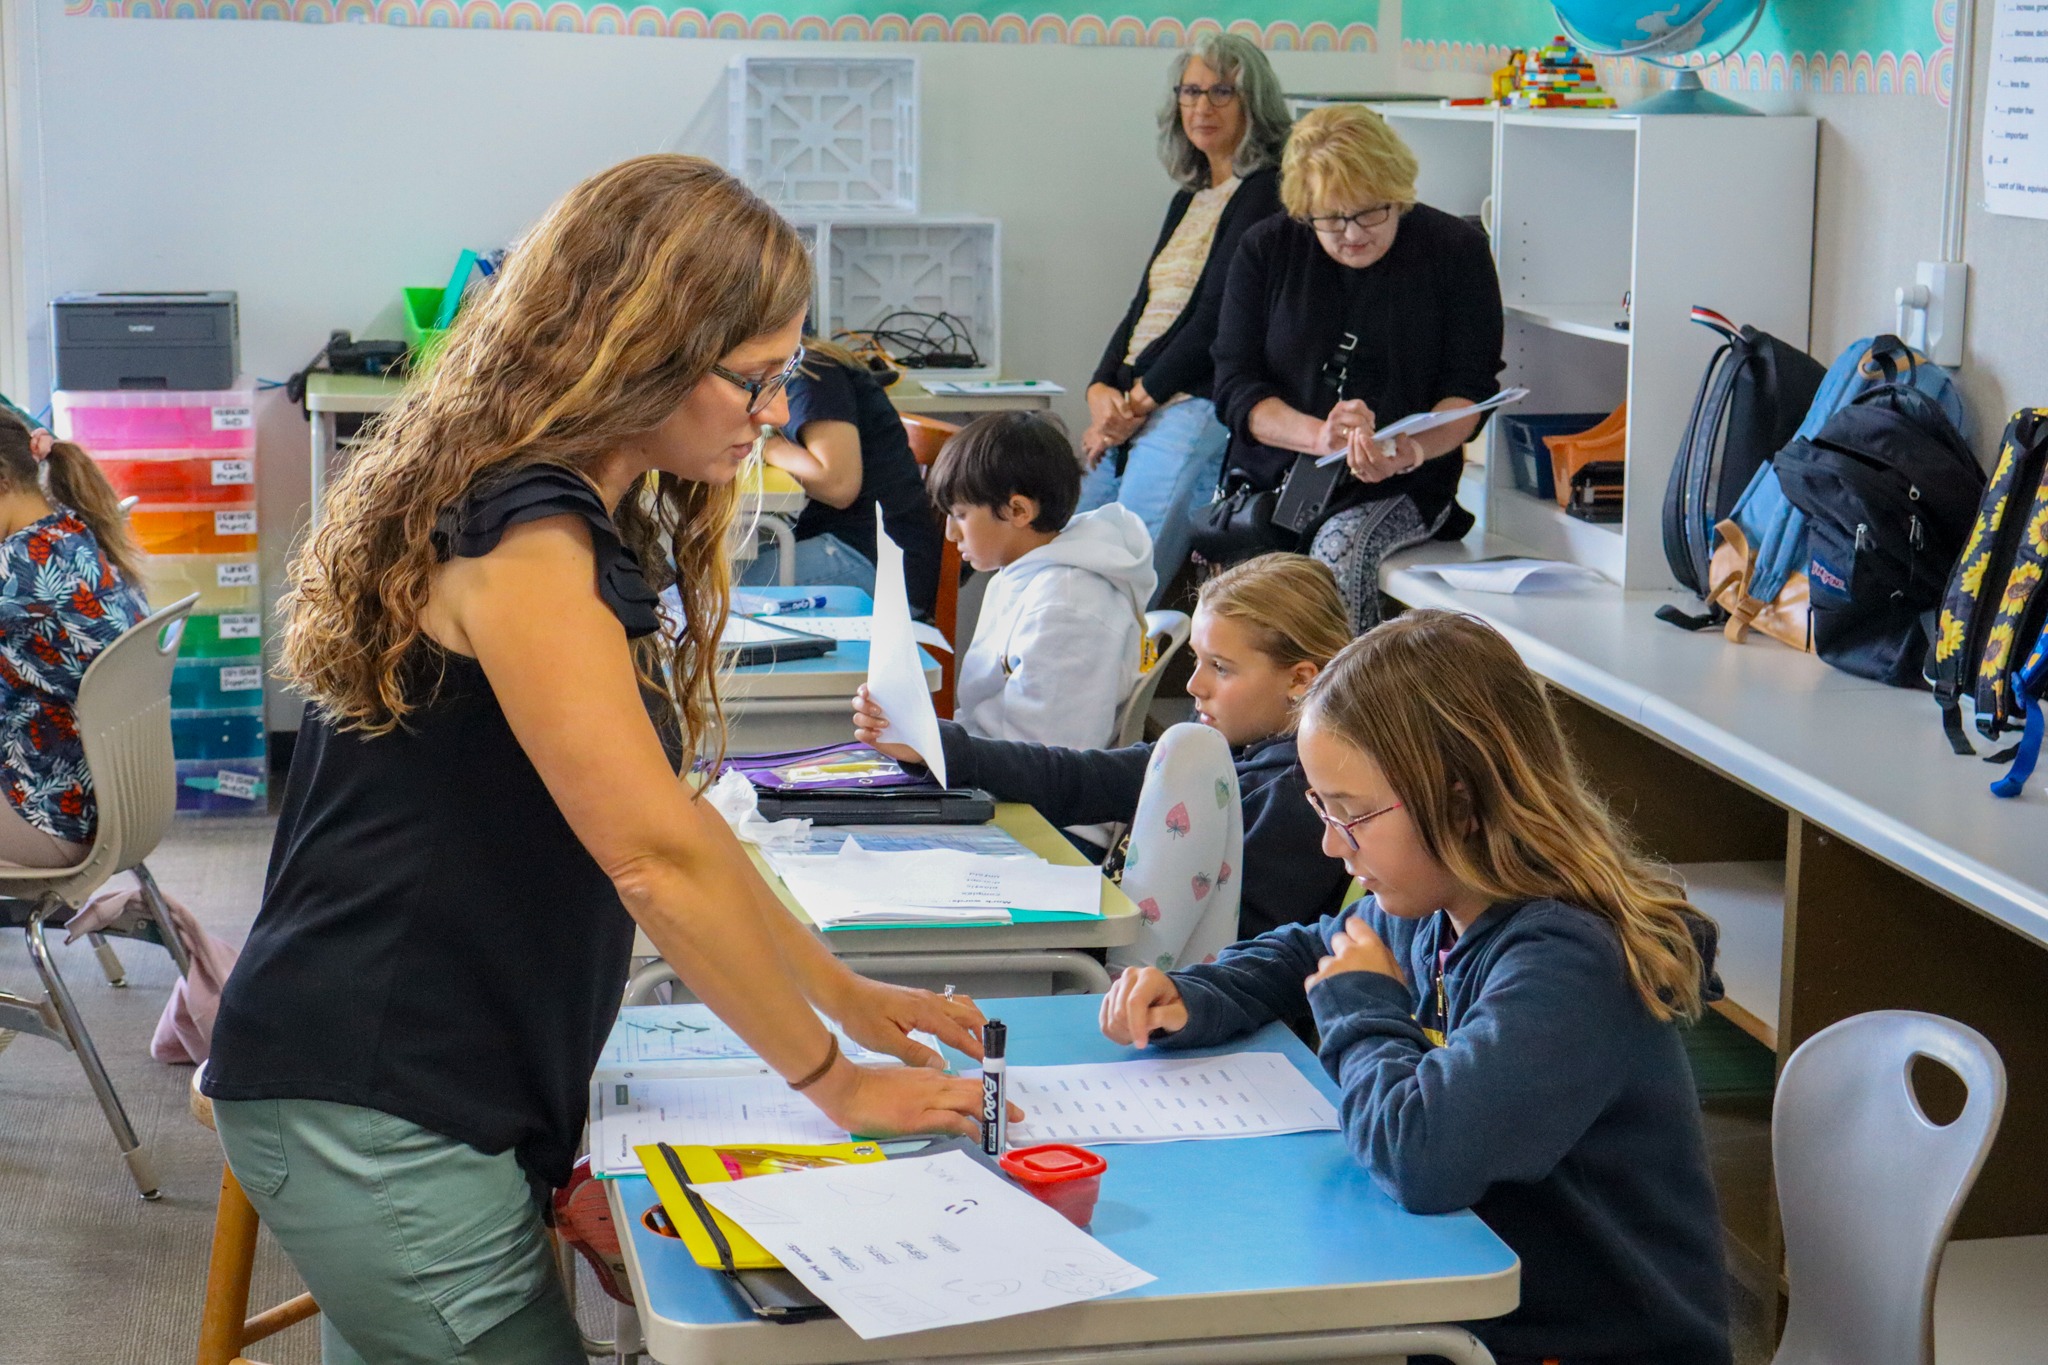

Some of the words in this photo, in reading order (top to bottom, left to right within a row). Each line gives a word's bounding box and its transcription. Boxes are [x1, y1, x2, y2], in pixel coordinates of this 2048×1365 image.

[2010, 80, 2020, 88] less
[2020, 81, 2030, 89] than
[2007, 106, 2024, 115] greater
[2024, 106, 2034, 115] than
[2004, 131, 2029, 141] important
[1998, 182, 2009, 190] sort
[983, 1074, 998, 1121] EXPO
[809, 1265, 833, 1282] Mark
